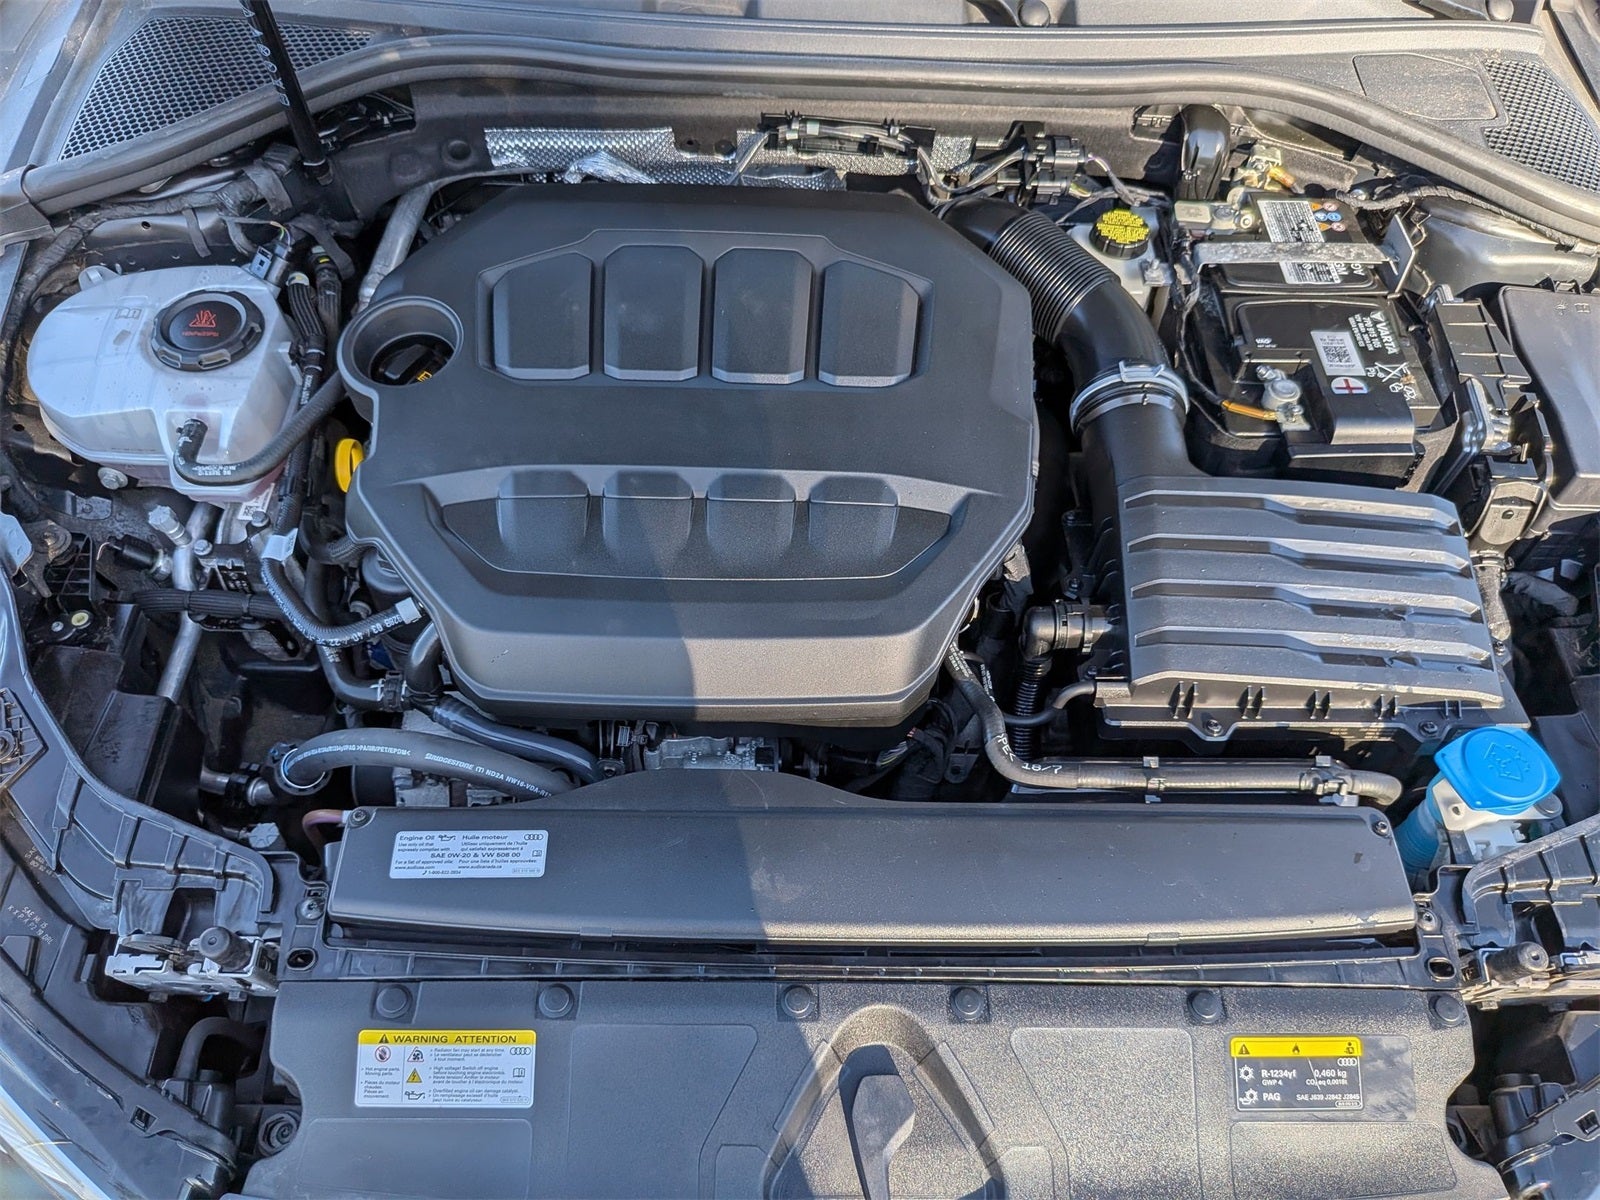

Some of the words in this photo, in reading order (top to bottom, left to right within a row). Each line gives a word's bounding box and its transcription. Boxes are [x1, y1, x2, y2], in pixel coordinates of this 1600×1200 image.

[1376, 322, 1400, 355] VARTA
[424, 752, 474, 770] BRIDGESTONE
[485, 769, 504, 780] ND2A
[1022, 762, 1062, 774] 18/7
[1261, 1070, 1296, 1079] R-1234yf
[1337, 1070, 1347, 1079] kg
